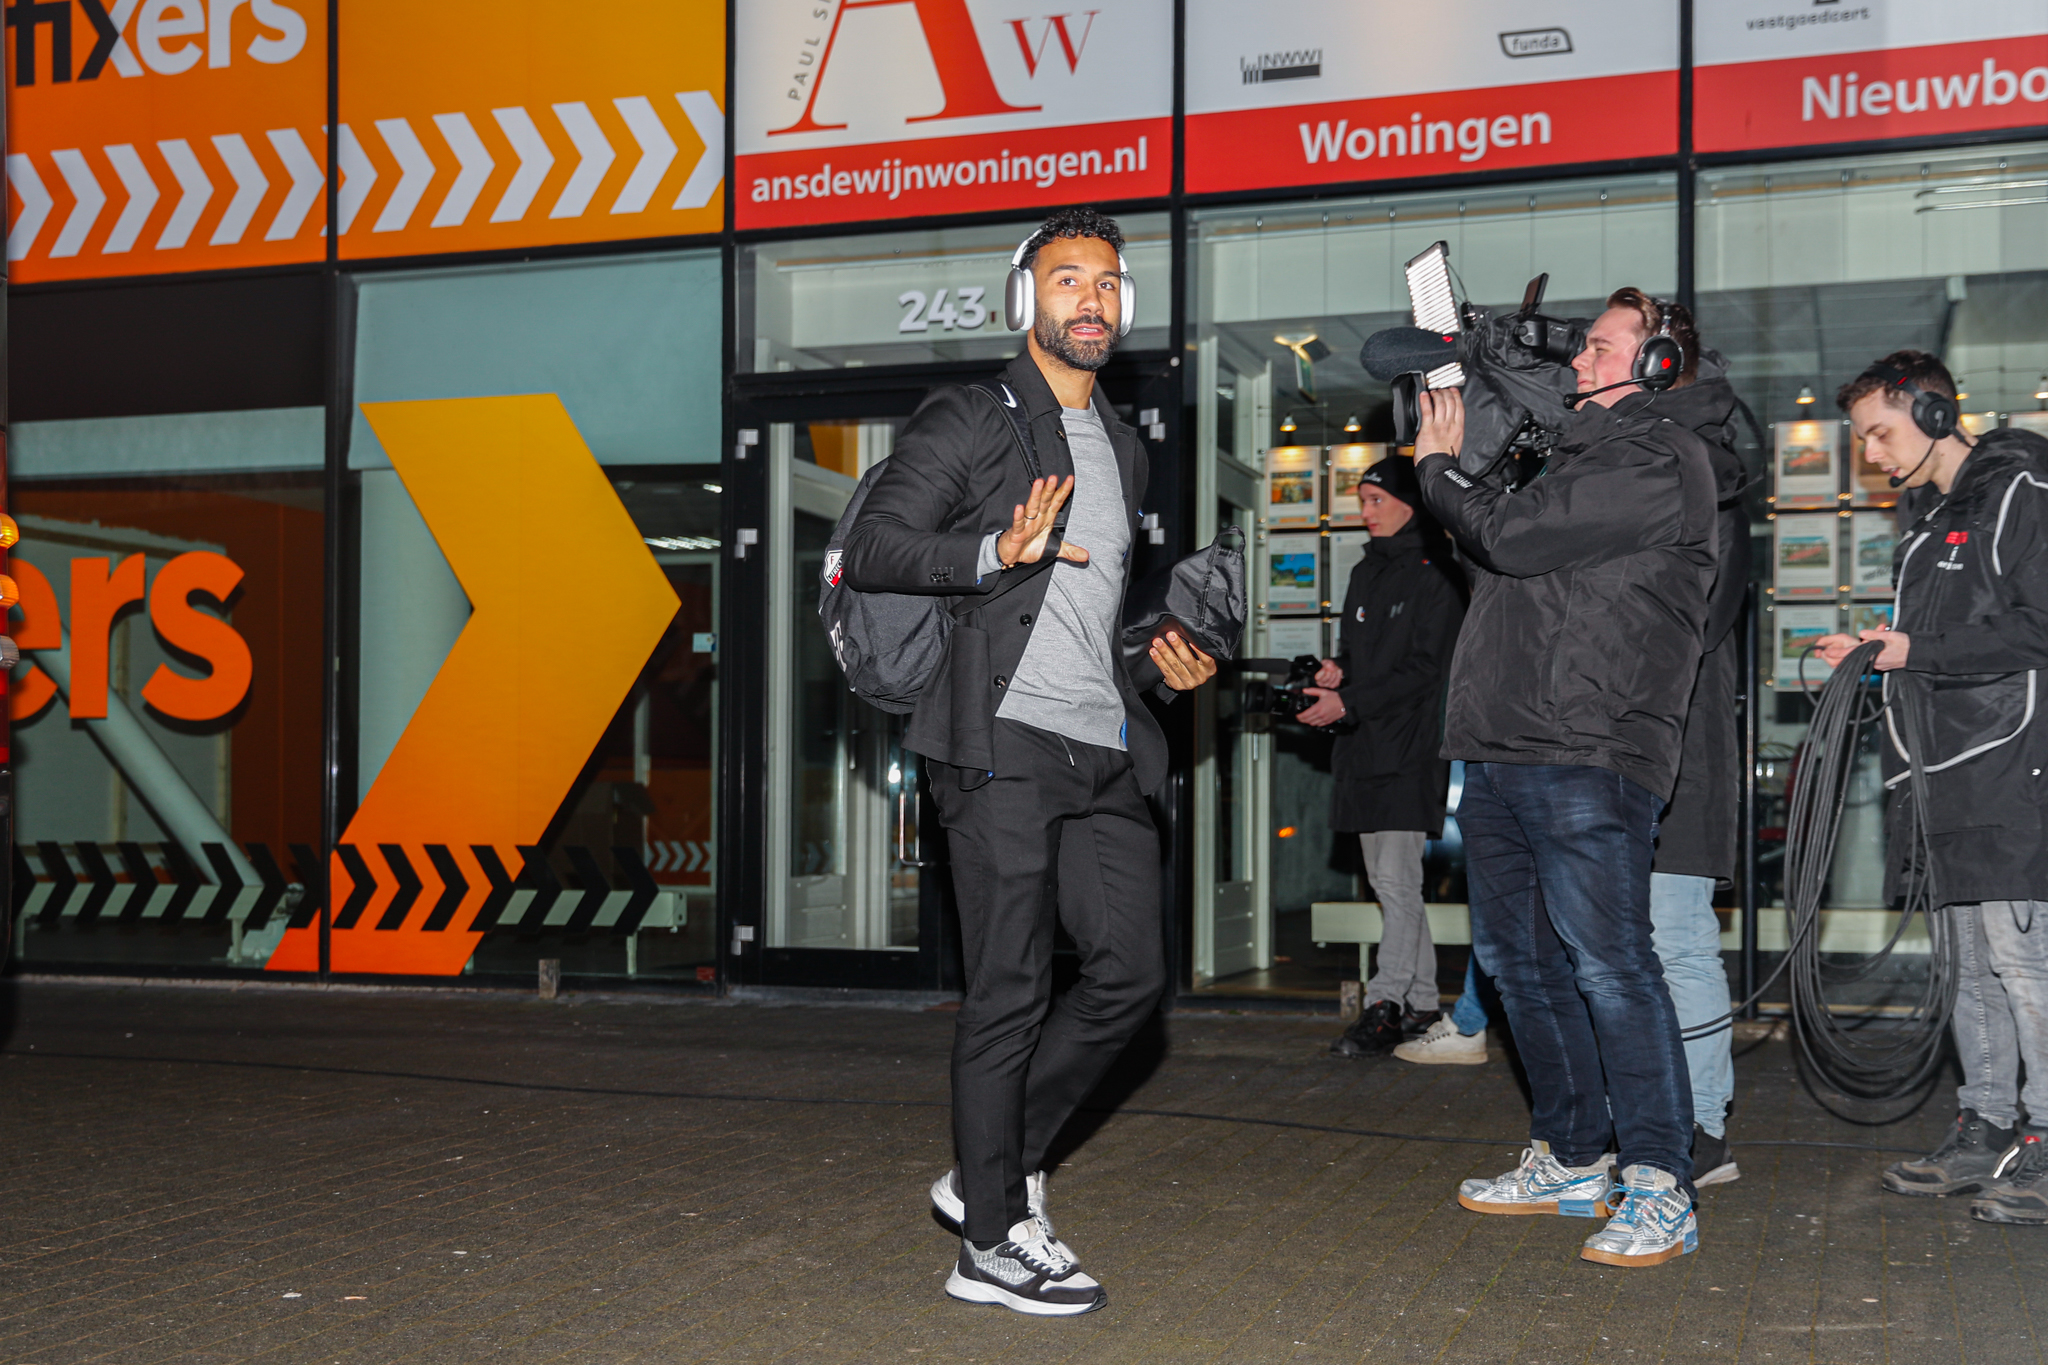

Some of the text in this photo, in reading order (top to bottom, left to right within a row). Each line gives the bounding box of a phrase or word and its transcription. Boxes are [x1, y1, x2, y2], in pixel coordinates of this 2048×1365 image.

[787, 36, 821, 101] PAUL
[1512, 34, 1561, 52] funda
[1802, 57, 2048, 122] Nieuwbo
[1299, 111, 1552, 164] Woningen
[751, 136, 1147, 203] ansdewijnwoningen.nl
[898, 286, 987, 334] 243
[830, 555, 835, 565] F
